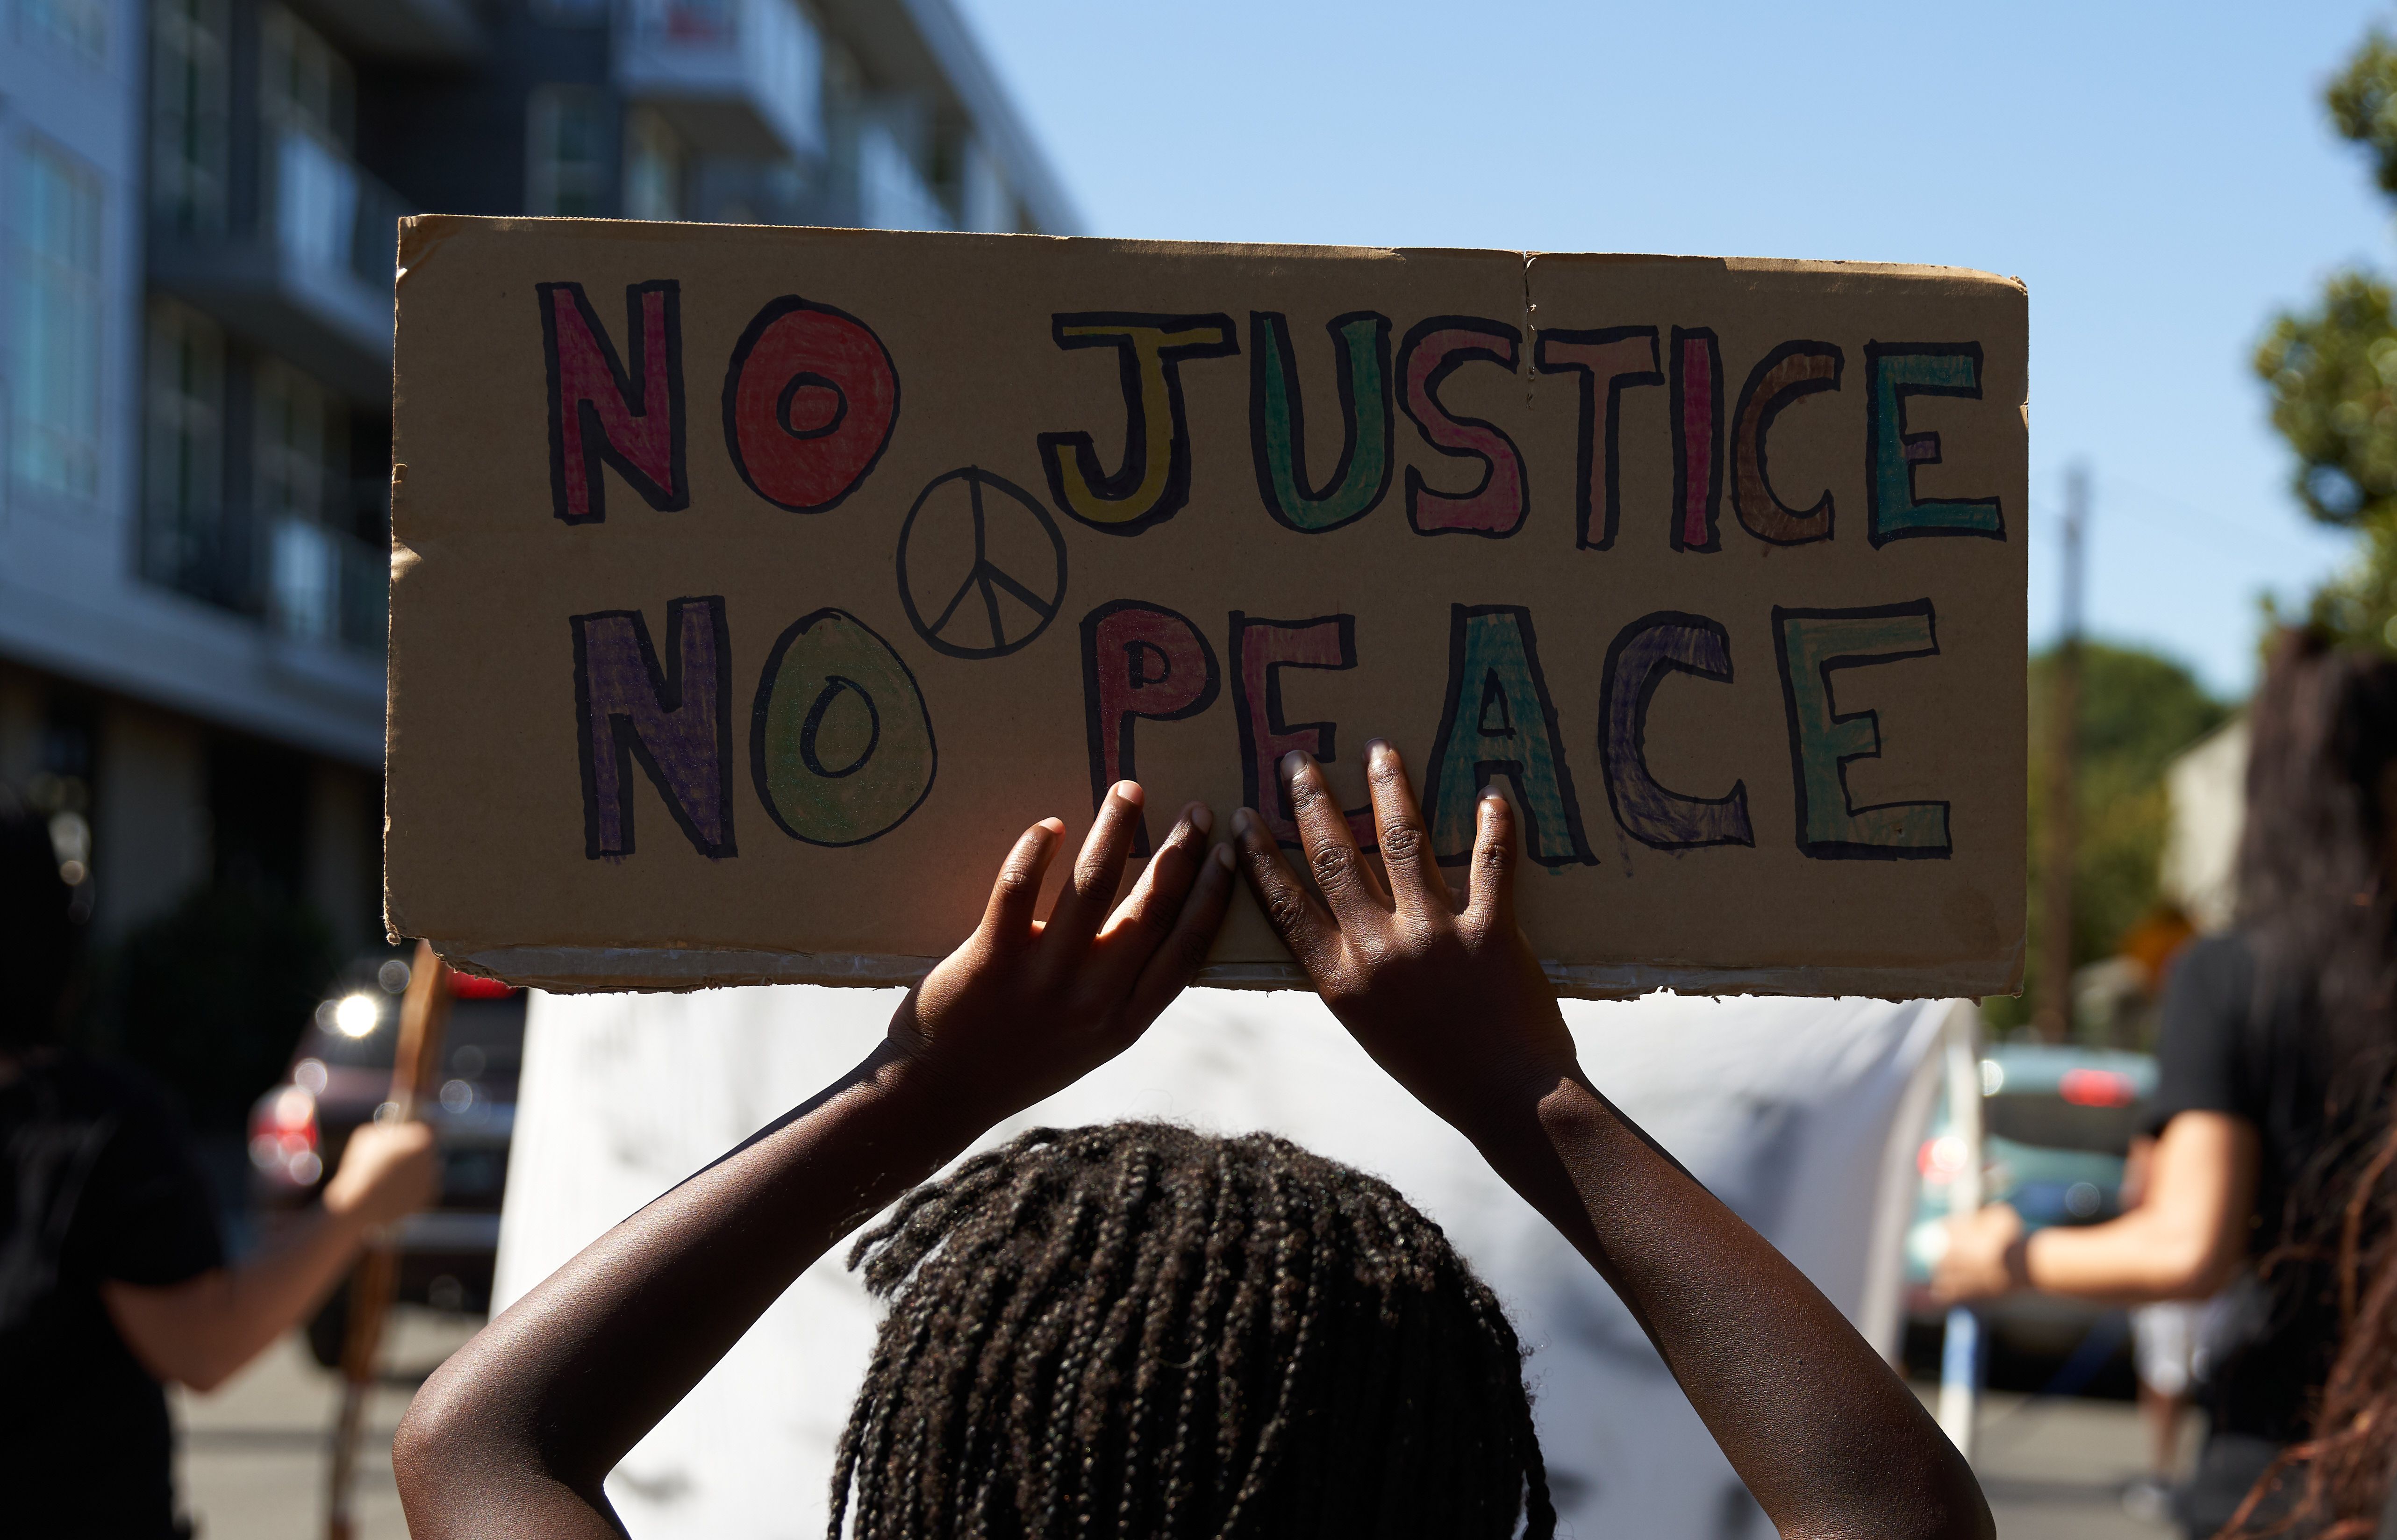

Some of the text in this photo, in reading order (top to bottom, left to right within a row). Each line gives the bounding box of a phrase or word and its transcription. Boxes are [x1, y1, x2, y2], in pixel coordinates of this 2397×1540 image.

[537, 280, 2005, 552] NO JUSTICE
[570, 596, 1950, 867] NO PEACE
